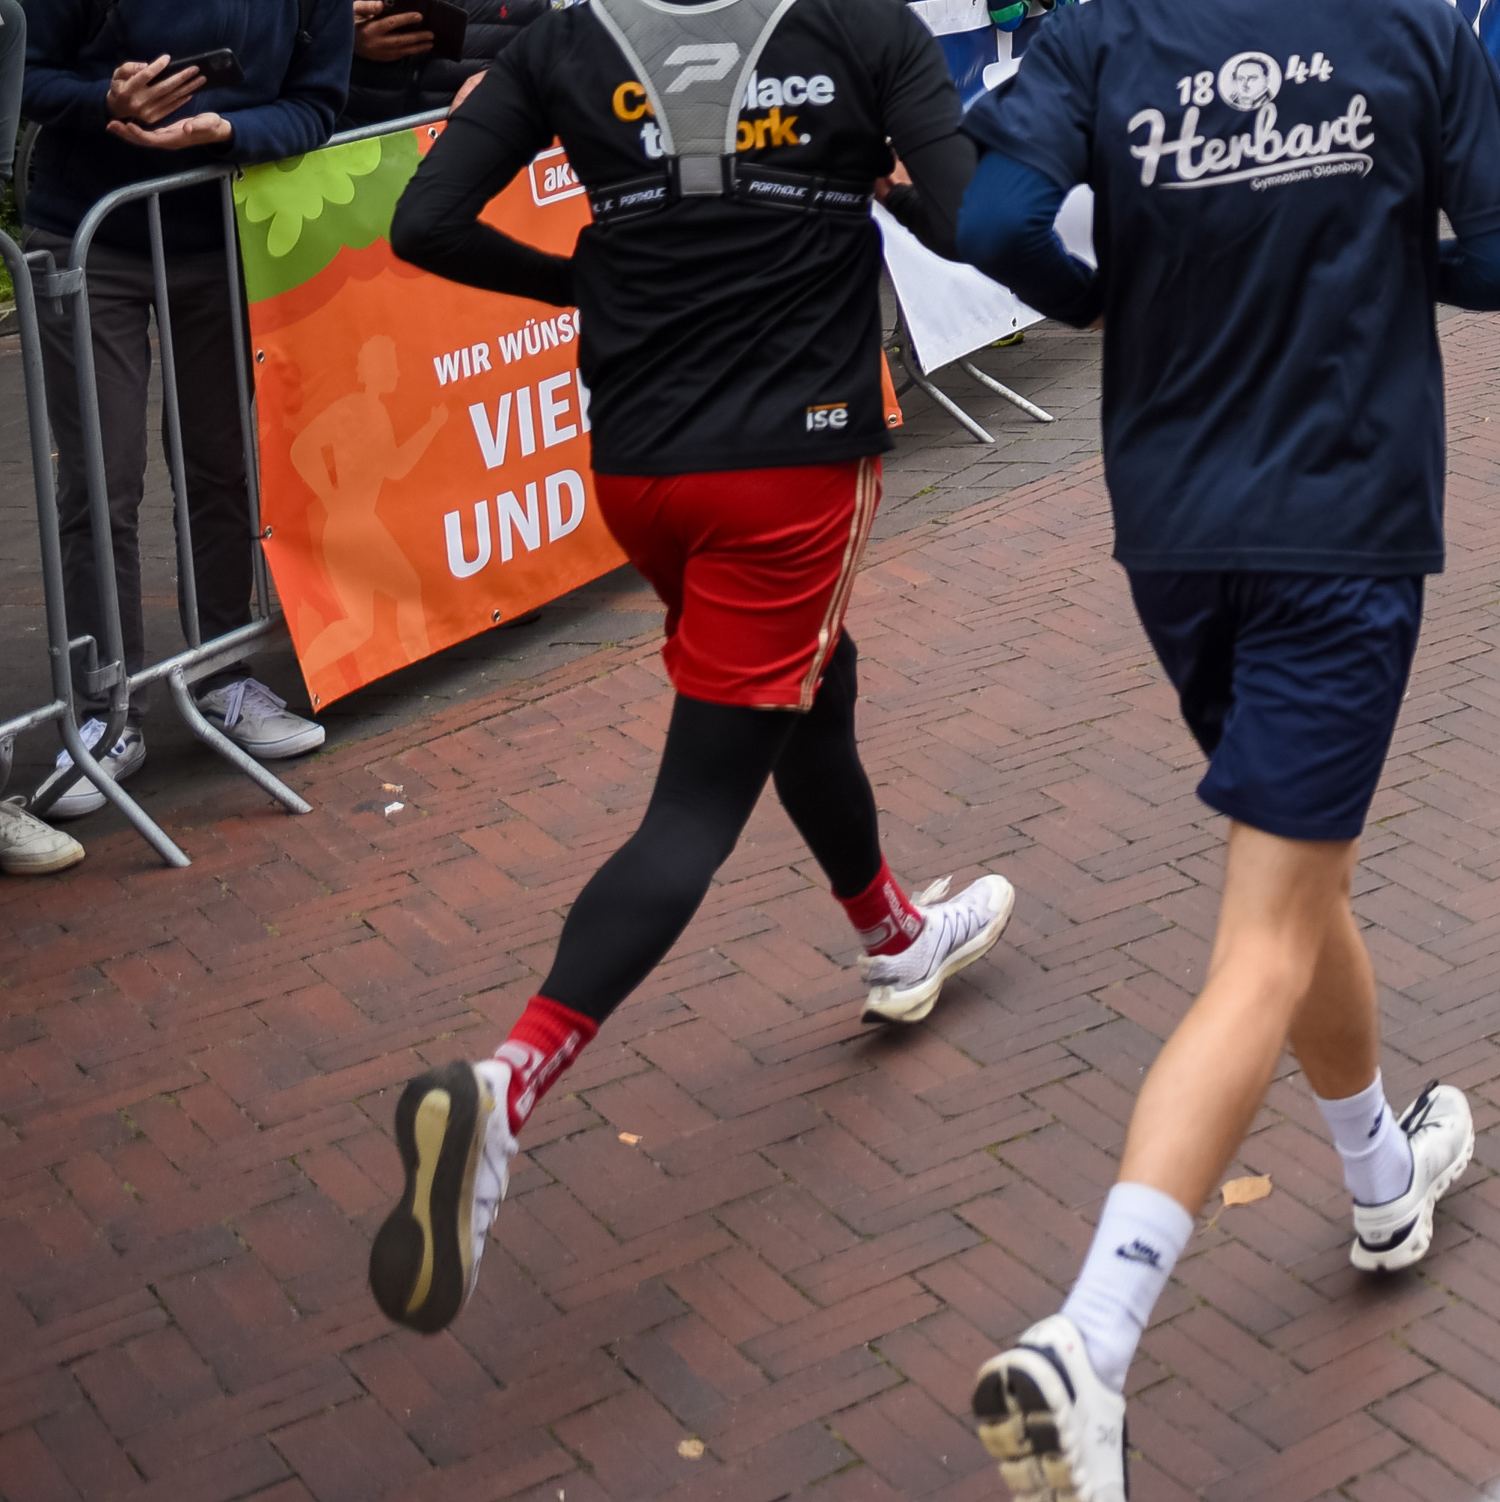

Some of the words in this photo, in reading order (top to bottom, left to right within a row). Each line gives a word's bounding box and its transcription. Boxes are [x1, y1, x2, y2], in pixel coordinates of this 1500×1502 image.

[740, 70, 835, 111] lace
[1176, 71, 1214, 106] 18
[1285, 52, 1333, 84] 44
[736, 108, 812, 151] ork.
[1128, 94, 1375, 187] Herbart
[750, 181, 807, 198] PORTHOLIC
[1250, 169, 1312, 191] Gymnasium
[433, 342, 492, 387] WIR
[806, 402, 848, 432] ise
[444, 469, 585, 578] UND
